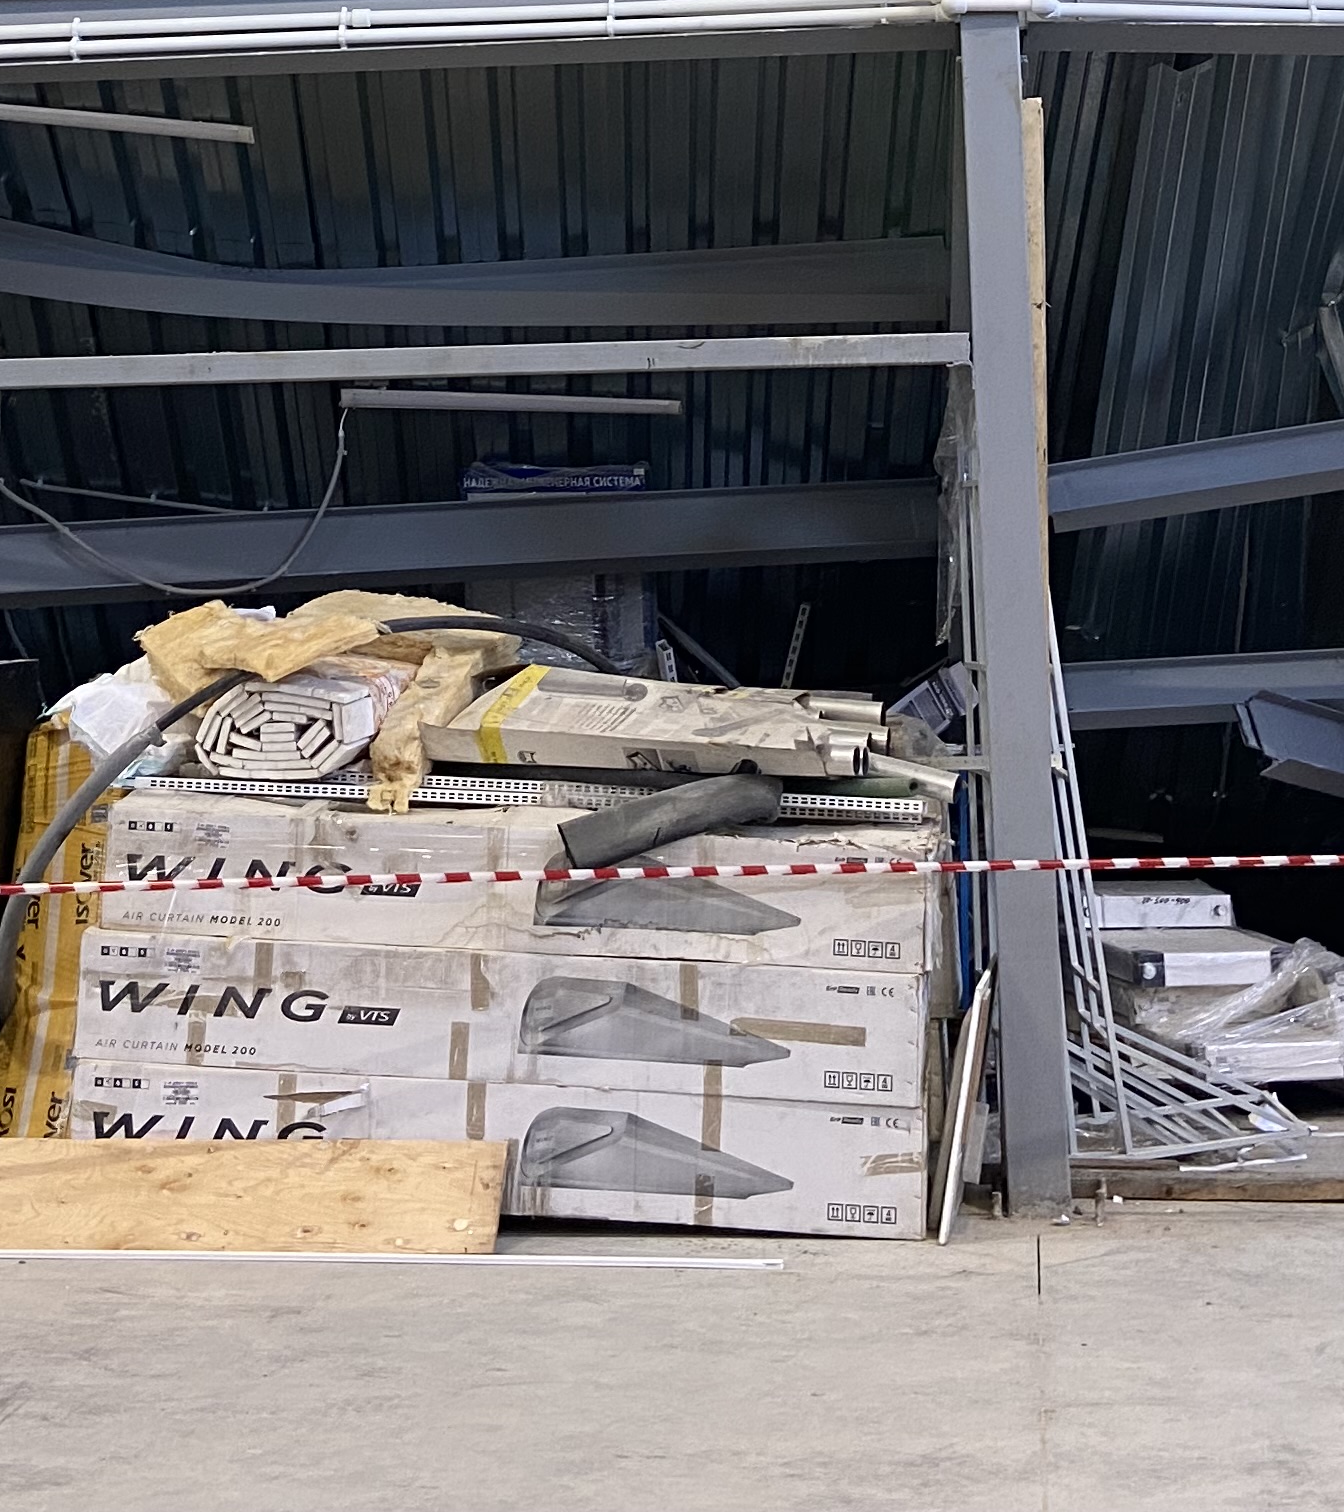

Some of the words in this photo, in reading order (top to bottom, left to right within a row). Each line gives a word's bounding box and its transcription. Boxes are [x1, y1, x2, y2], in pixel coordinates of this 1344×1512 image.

[592, 475, 642, 488] СИСТЕМА
[122, 910, 144, 922] AIR
[149, 911, 205, 925] CURTAIN
[209, 913, 253, 927] MODEL
[257, 916, 282, 928] 200
[99, 979, 331, 1023] WING
[359, 1009, 392, 1022] VTS
[95, 1038, 117, 1050] AIR
[122, 1039, 178, 1053] CURTAIN
[183, 1042, 228, 1055] MODEL
[231, 1044, 257, 1056] 200
